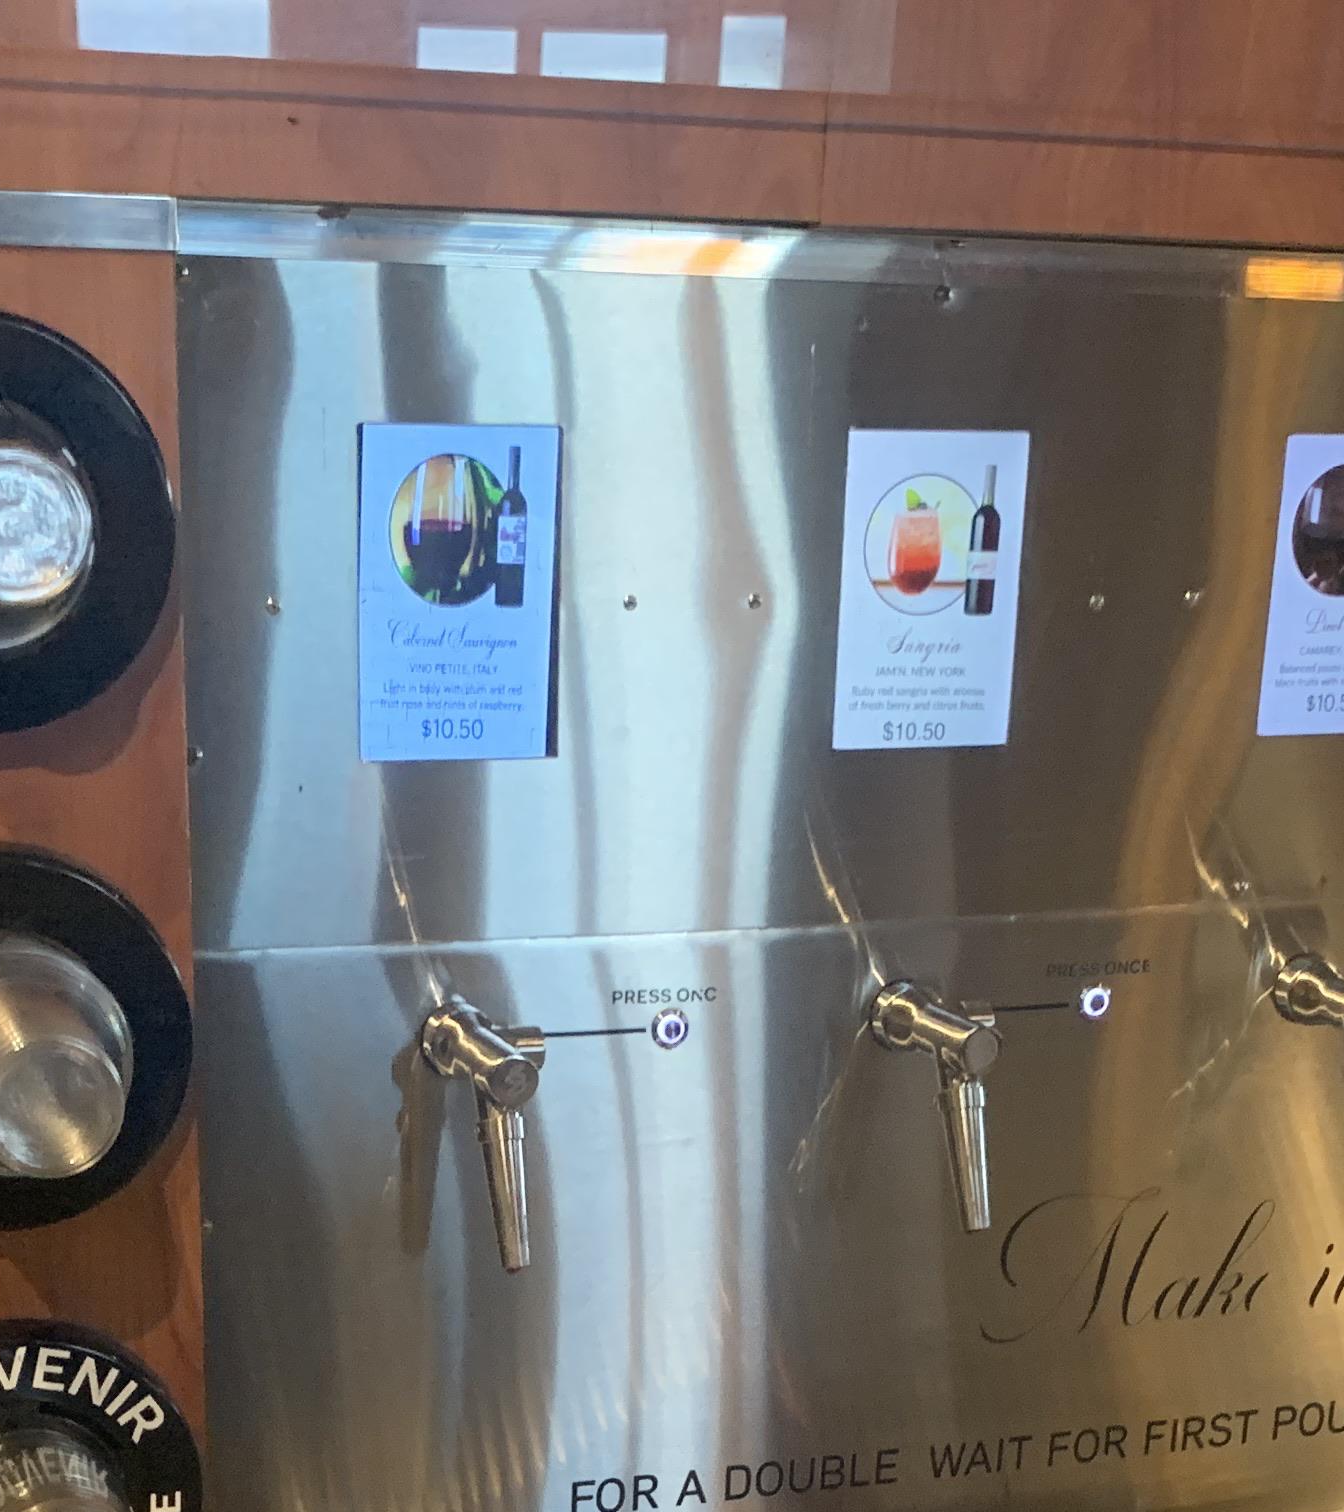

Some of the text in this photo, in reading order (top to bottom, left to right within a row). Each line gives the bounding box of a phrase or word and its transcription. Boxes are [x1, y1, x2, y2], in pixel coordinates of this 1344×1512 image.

[887, 626, 961, 663] Sangria
[911, 666, 936, 677] NEW
[939, 666, 966, 677] YORK
[422, 718, 484, 740] $10.50
[882, 721, 946, 741] $10.50
[1104, 959, 1152, 974] ONCE
[612, 988, 671, 1005] PRESS
[979, 1186, 1276, 1344] Make
[676, 1470, 707, 1507] A
[724, 1448, 900, 1501] DOUBLE
[930, 1435, 1033, 1479] WAIT
[1047, 1424, 1129, 1468] FOR
[1143, 1409, 1259, 1456] FIRST
